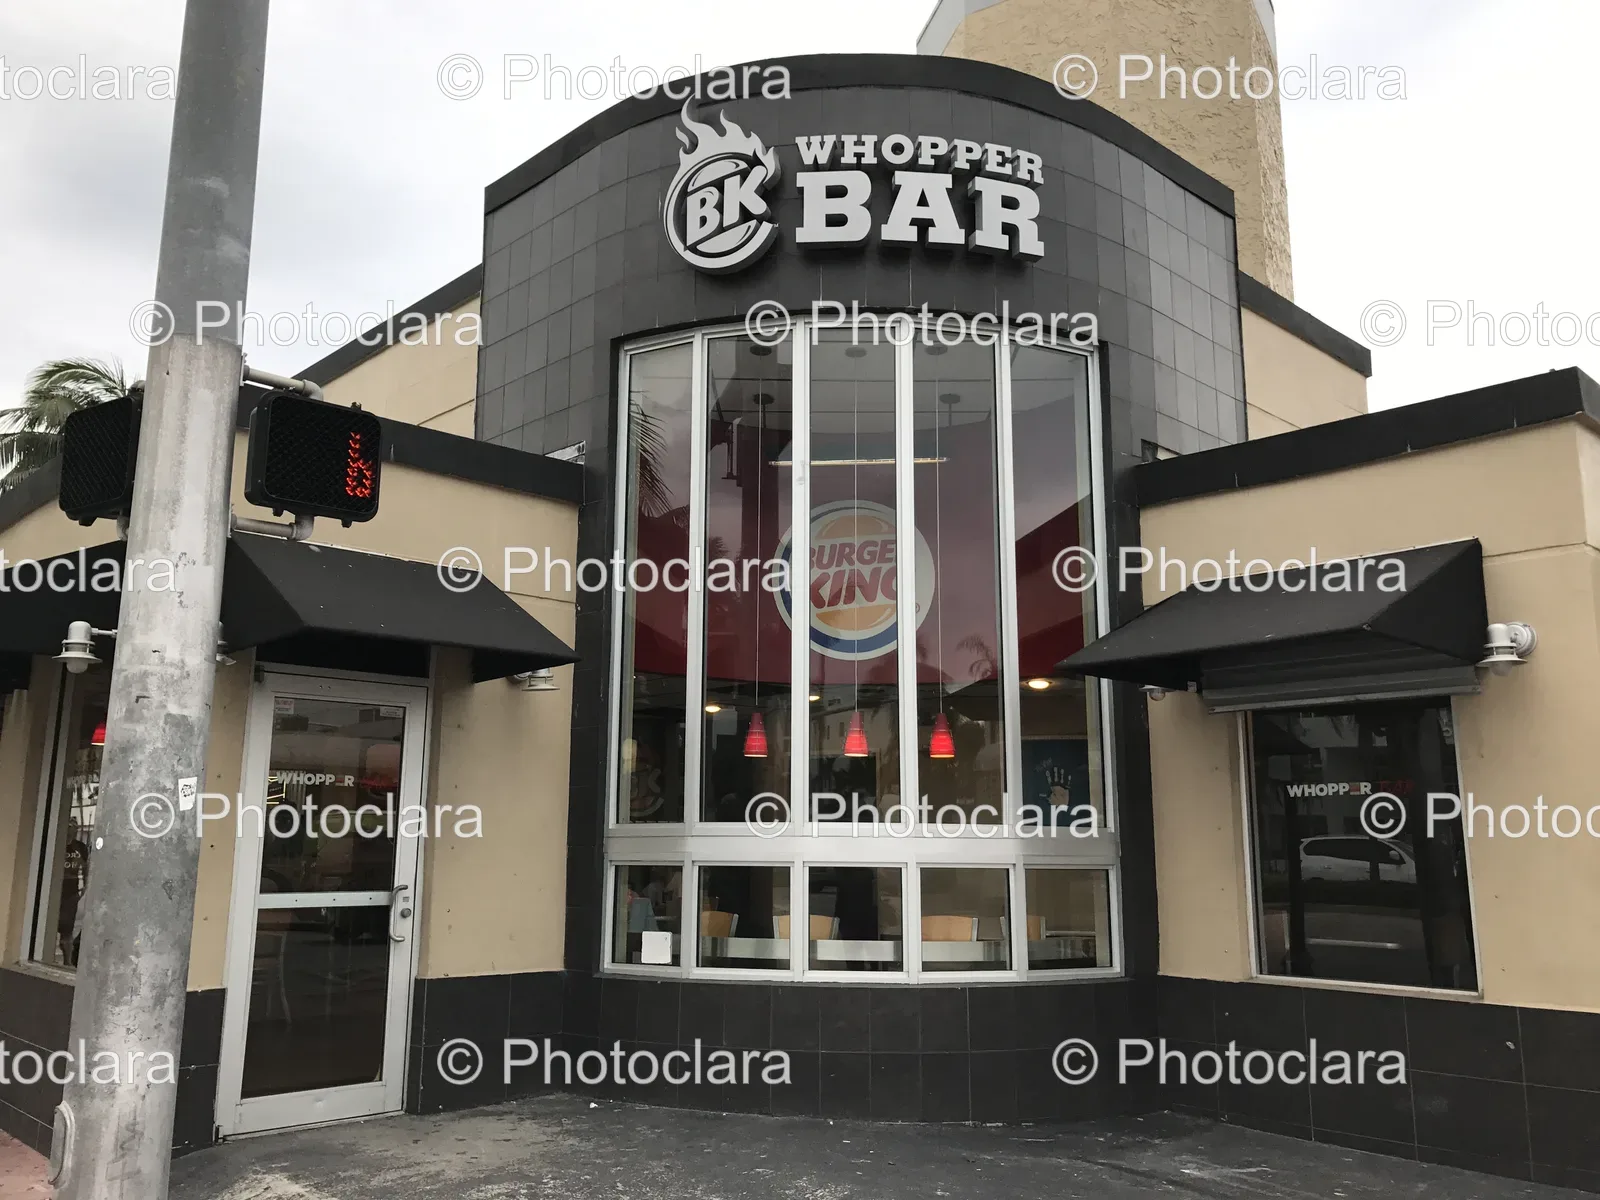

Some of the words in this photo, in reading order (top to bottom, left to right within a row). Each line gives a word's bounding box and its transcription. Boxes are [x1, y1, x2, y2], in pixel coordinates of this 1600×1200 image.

[795, 133, 1044, 185] WHOPPER
[686, 165, 769, 249] BK
[795, 170, 1046, 259] BAR
[811, 540, 897, 570] URGE
